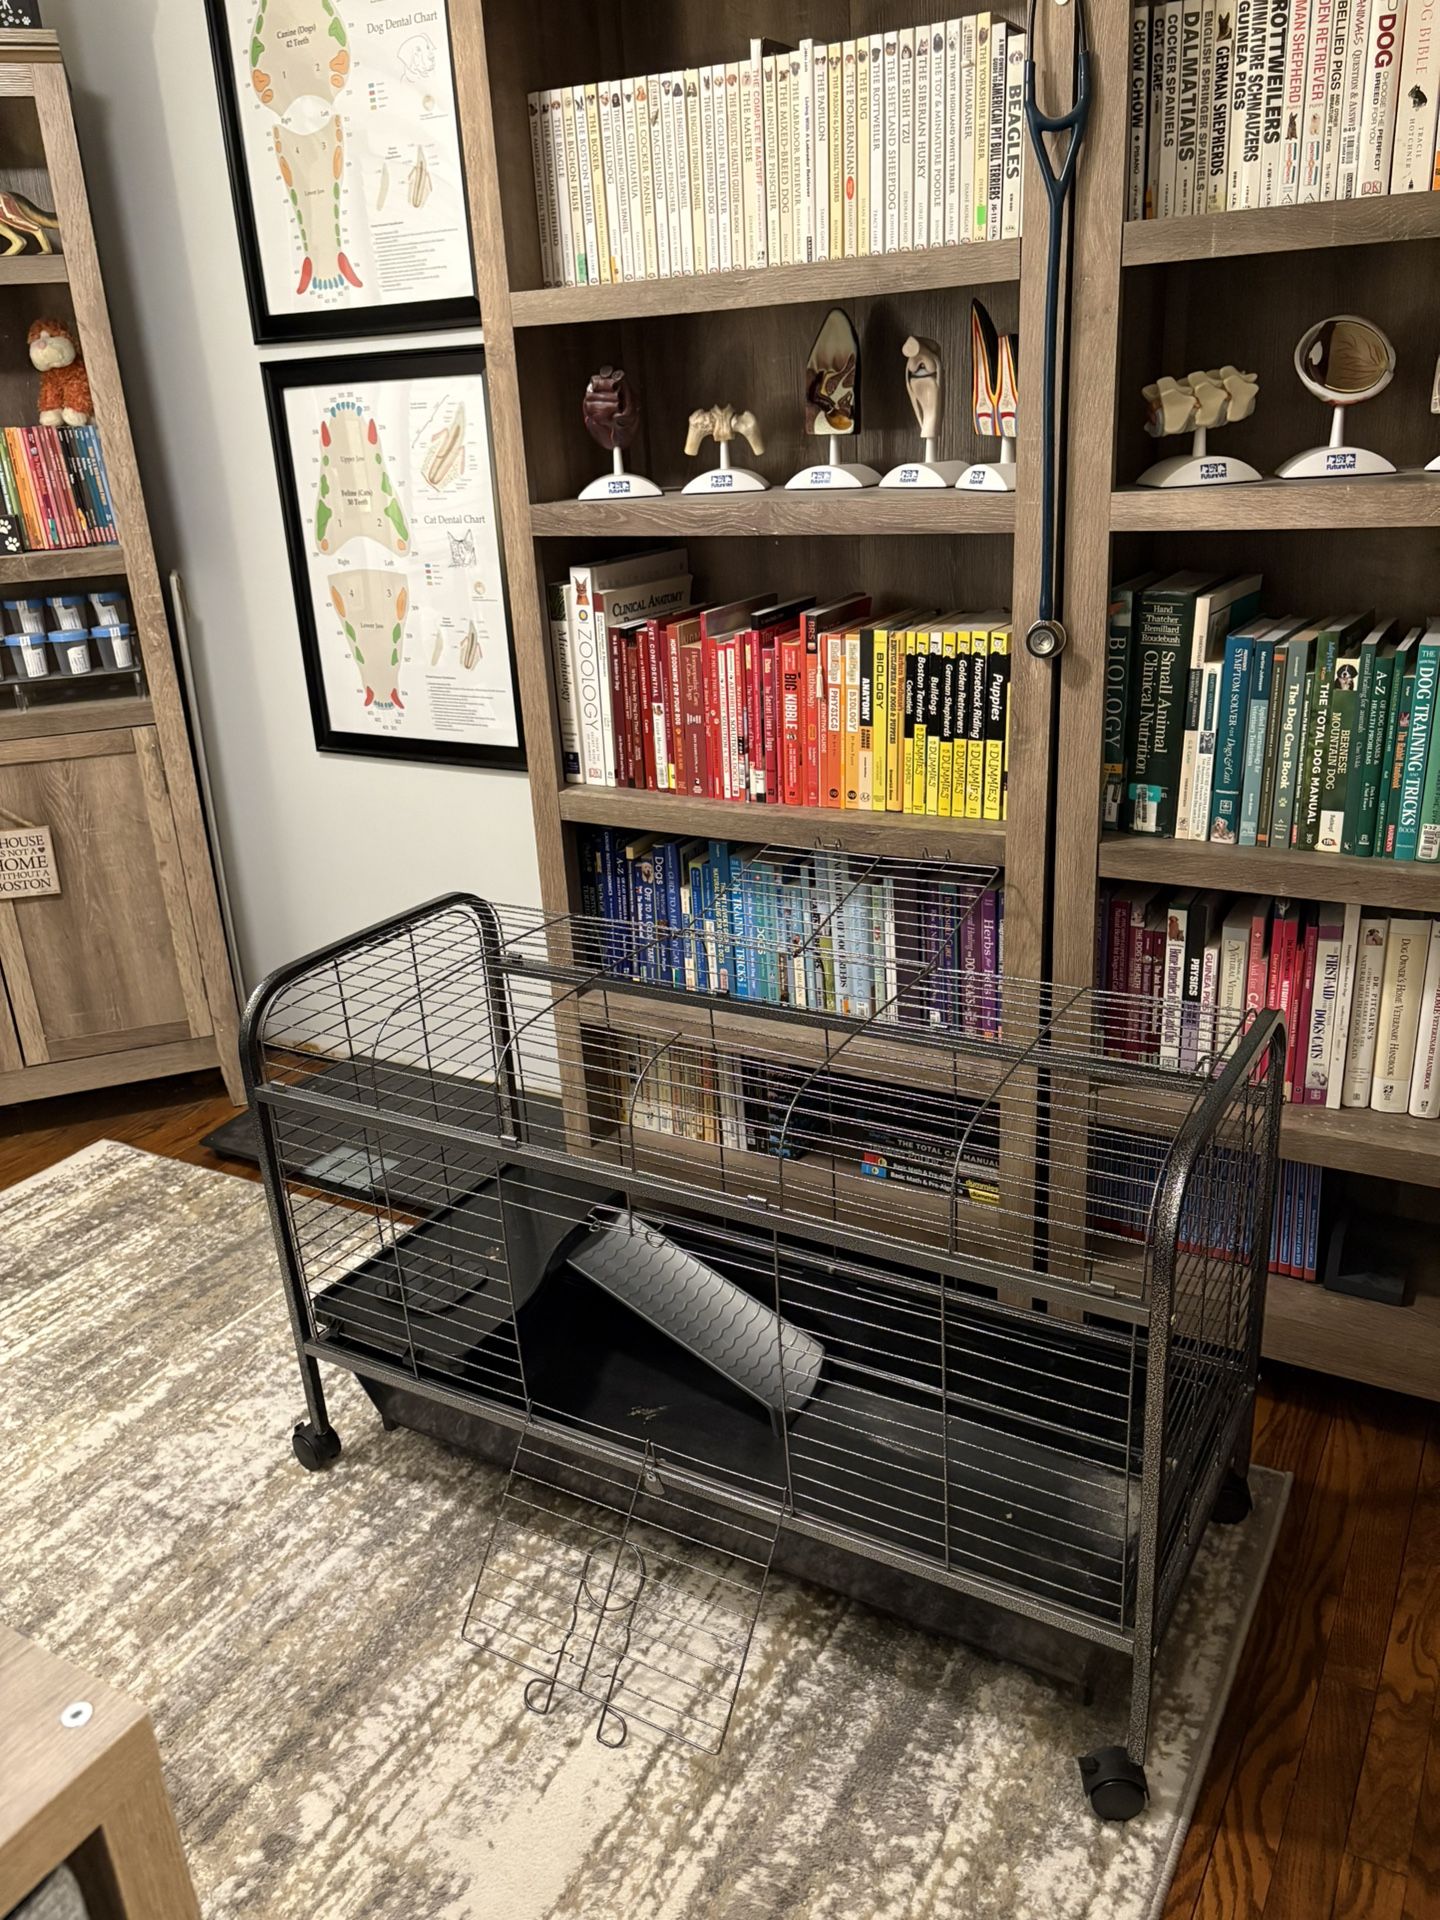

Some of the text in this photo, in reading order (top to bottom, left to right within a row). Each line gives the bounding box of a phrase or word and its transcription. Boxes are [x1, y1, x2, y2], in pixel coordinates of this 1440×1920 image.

[277, 23, 316, 39] Canine (Dogs)
[294, 37, 310, 47] Teeth
[367, 11, 438, 34] Dog Dental Chart
[1375, 14, 1396, 68] DOG
[919, 59, 927, 82] THE
[1132, 20, 1145, 128] CHOW CHOW
[1234, 1, 1250, 110] GUINEA PIGS
[1289, 34, 1305, 103] SHEPHERD
[1312, 28, 1328, 100] RETRIEVER
[1331, 61, 1344, 90] PIGS
[1416, 28, 1430, 74] BIBLE
[859, 69, 867, 94] THE
[902, 61, 910, 143] THE SHIH TZU
[1164, 14, 1177, 147] COCKER SPANIELS
[1179, 12, 1200, 161] DALMATIANS
[1196, 11, 1212, 191] ENGLISH SPRINGER SPANIELS
[1373, 72, 1381, 105] BREED
[1381, 71, 1389, 106] CHOOSE
[887, 59, 896, 210] THE SHETLAND SHEEPDOG
[918, 85, 926, 137] SIBERIAN
[1006, 85, 1022, 179] BEAGLES
[1210, 47, 1230, 176] GERMAN SHEPHERDS
[1244, 75, 1262, 162] SCHNAUZERS
[579, 137, 589, 180] BOSTON
[990, 83, 1002, 200] AMERICAN PIT BULL TERRIERS
[1374, 129, 1384, 171] PERFECT
[583, 183, 592, 224] TERRIER
[424, 515, 485, 524] Cat Dental Chart
[1146, 615, 1179, 623] Thatcher
[1154, 605, 1173, 613] Hand
[556, 629, 572, 703] Microbiology
[578, 629, 599, 730] ZOOLOGY
[648, 627, 659, 697] VET CONFIDENTIAL
[807, 621, 816, 708] BRS Pathology
[876, 653, 884, 709] BIOLOGY
[1228, 648, 1243, 726] SYMPTOM SOLVER
[1417, 668, 1433, 700] DOG
[672, 697, 680, 713] YOUR
[784, 673, 798, 730] BIG KIBBLE
[830, 690, 839, 728] PHYSICS
[849, 691, 857, 729] BIOLOGY
[916, 657, 925, 722] Boston Terriers
[929, 677, 939, 715] Bulldogs
[943, 664, 953, 736] German Shepherds
[956, 660, 967, 733] Golden Retrievers
[970, 658, 984, 738] Horseback Riding
[990, 674, 1003, 720] Puppies
[1104, 637, 1127, 749] BIOLOGY
[1135, 651, 1159, 774] Clinical Nutrition
[1154, 651, 1176, 752] Small Animal
[915, 733, 925, 776] DUMMIES
[1280, 684, 1299, 788] The Dog Care Book
[1307, 683, 1330, 824] THE TOTAL DOG MANUAL
[1325, 713, 1341, 789] MOUNTAIN DOG
[1338, 730, 1350, 774] BERNESE
[1392, 731, 1408, 788] The Rabbit Handbook
[1408, 704, 1430, 772] TRAINING
[928, 746, 937, 787] DUMMIES
[941, 755, 950, 799] DUMMIES
[955, 750, 965, 794] DUMMIES
[970, 750, 980, 801] DUMMIES
[987, 751, 999, 802] DUMMIES
[1401, 778, 1420, 825] TRICKS
[0, 835, 44, 848] HOUSE
[7, 848, 28, 856] NOT
[0, 870, 40, 880] ITHOUT
[654, 856, 664, 884] Dogs
[984, 920, 994, 956] Herbs
[737, 950, 747, 982] TRICKS
[1189, 958, 1199, 995] PHYSICS
[1202, 953, 1213, 1012] GUINEA PIGS
[1367, 994, 1378, 1040] PITCAIRN'S
[1386, 938, 1412, 1076] DOG OWNER'S HOME VETERINARY HANDBOOK
[1311, 1010, 1327, 1059] DOGS CATS
[898, 1140, 999, 1167] THE TOTAL MANUAL
